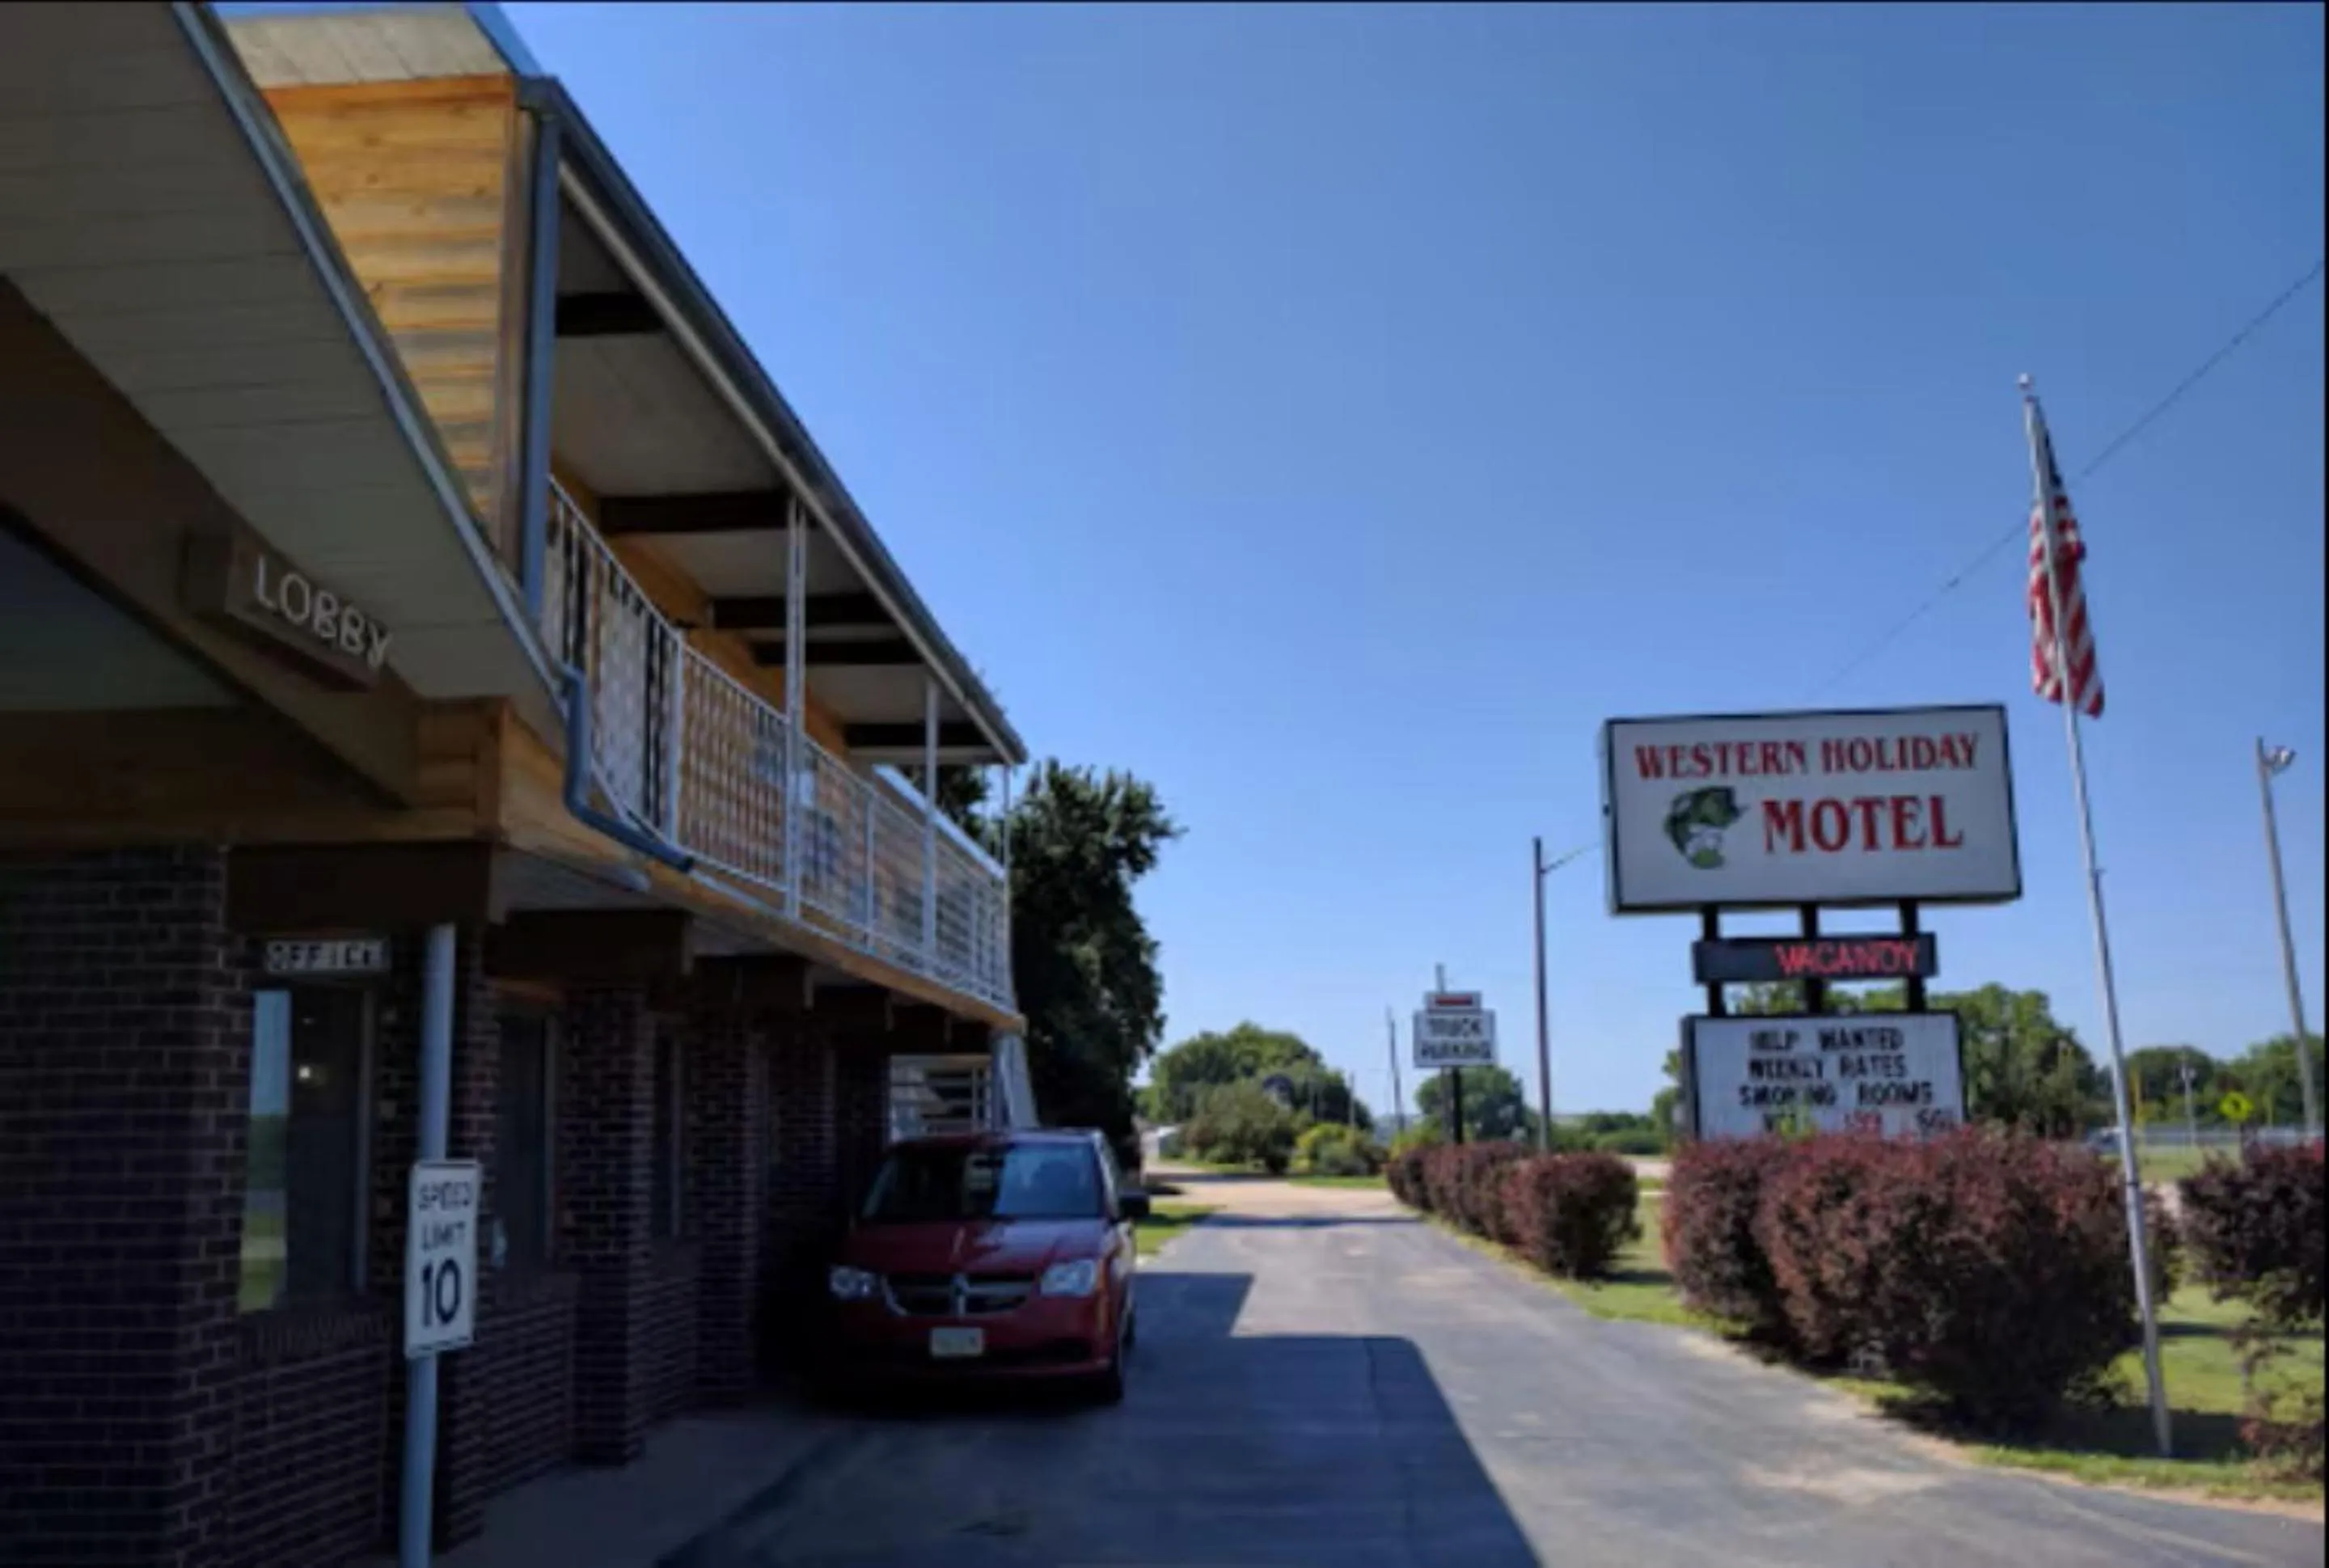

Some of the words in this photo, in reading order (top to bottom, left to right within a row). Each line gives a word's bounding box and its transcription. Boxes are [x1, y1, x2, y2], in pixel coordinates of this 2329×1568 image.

[256, 555, 394, 670] LOBBY
[1634, 740, 1808, 780] WESTERN
[1820, 733, 1979, 774] HOLIDAY
[1760, 795, 1965, 854] MOTEL
[1748, 1029, 1800, 1051] HELP
[1817, 1027, 1904, 1052] WANTED
[1748, 1057, 1824, 1080] WEEKLY
[1839, 1054, 1908, 1079] RATES
[1857, 1080, 1933, 1105] ROOMS
[418, 1181, 471, 1211] SPEED
[420, 1221, 467, 1252] LIMIT
[421, 1257, 463, 1330] 10
